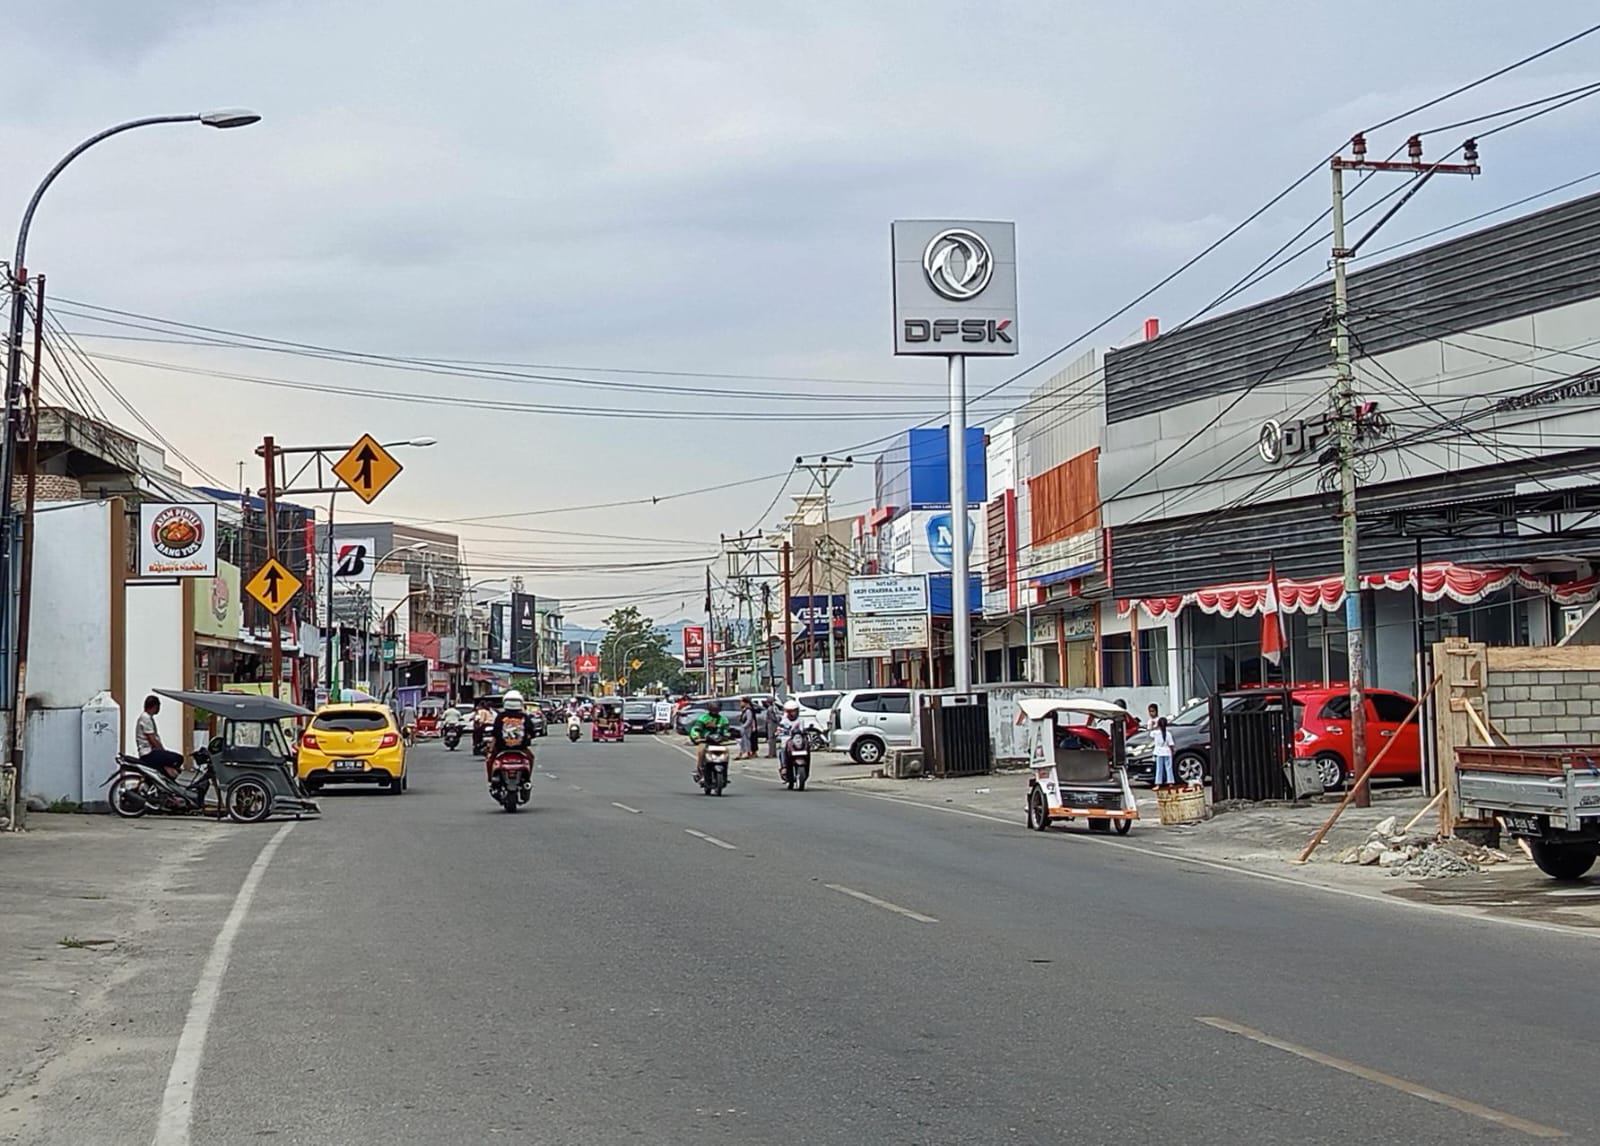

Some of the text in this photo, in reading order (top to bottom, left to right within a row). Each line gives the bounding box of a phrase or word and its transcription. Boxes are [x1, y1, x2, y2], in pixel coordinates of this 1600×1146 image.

[904, 319, 1012, 343] DFSK
[157, 542, 199, 557] BANG YUS
